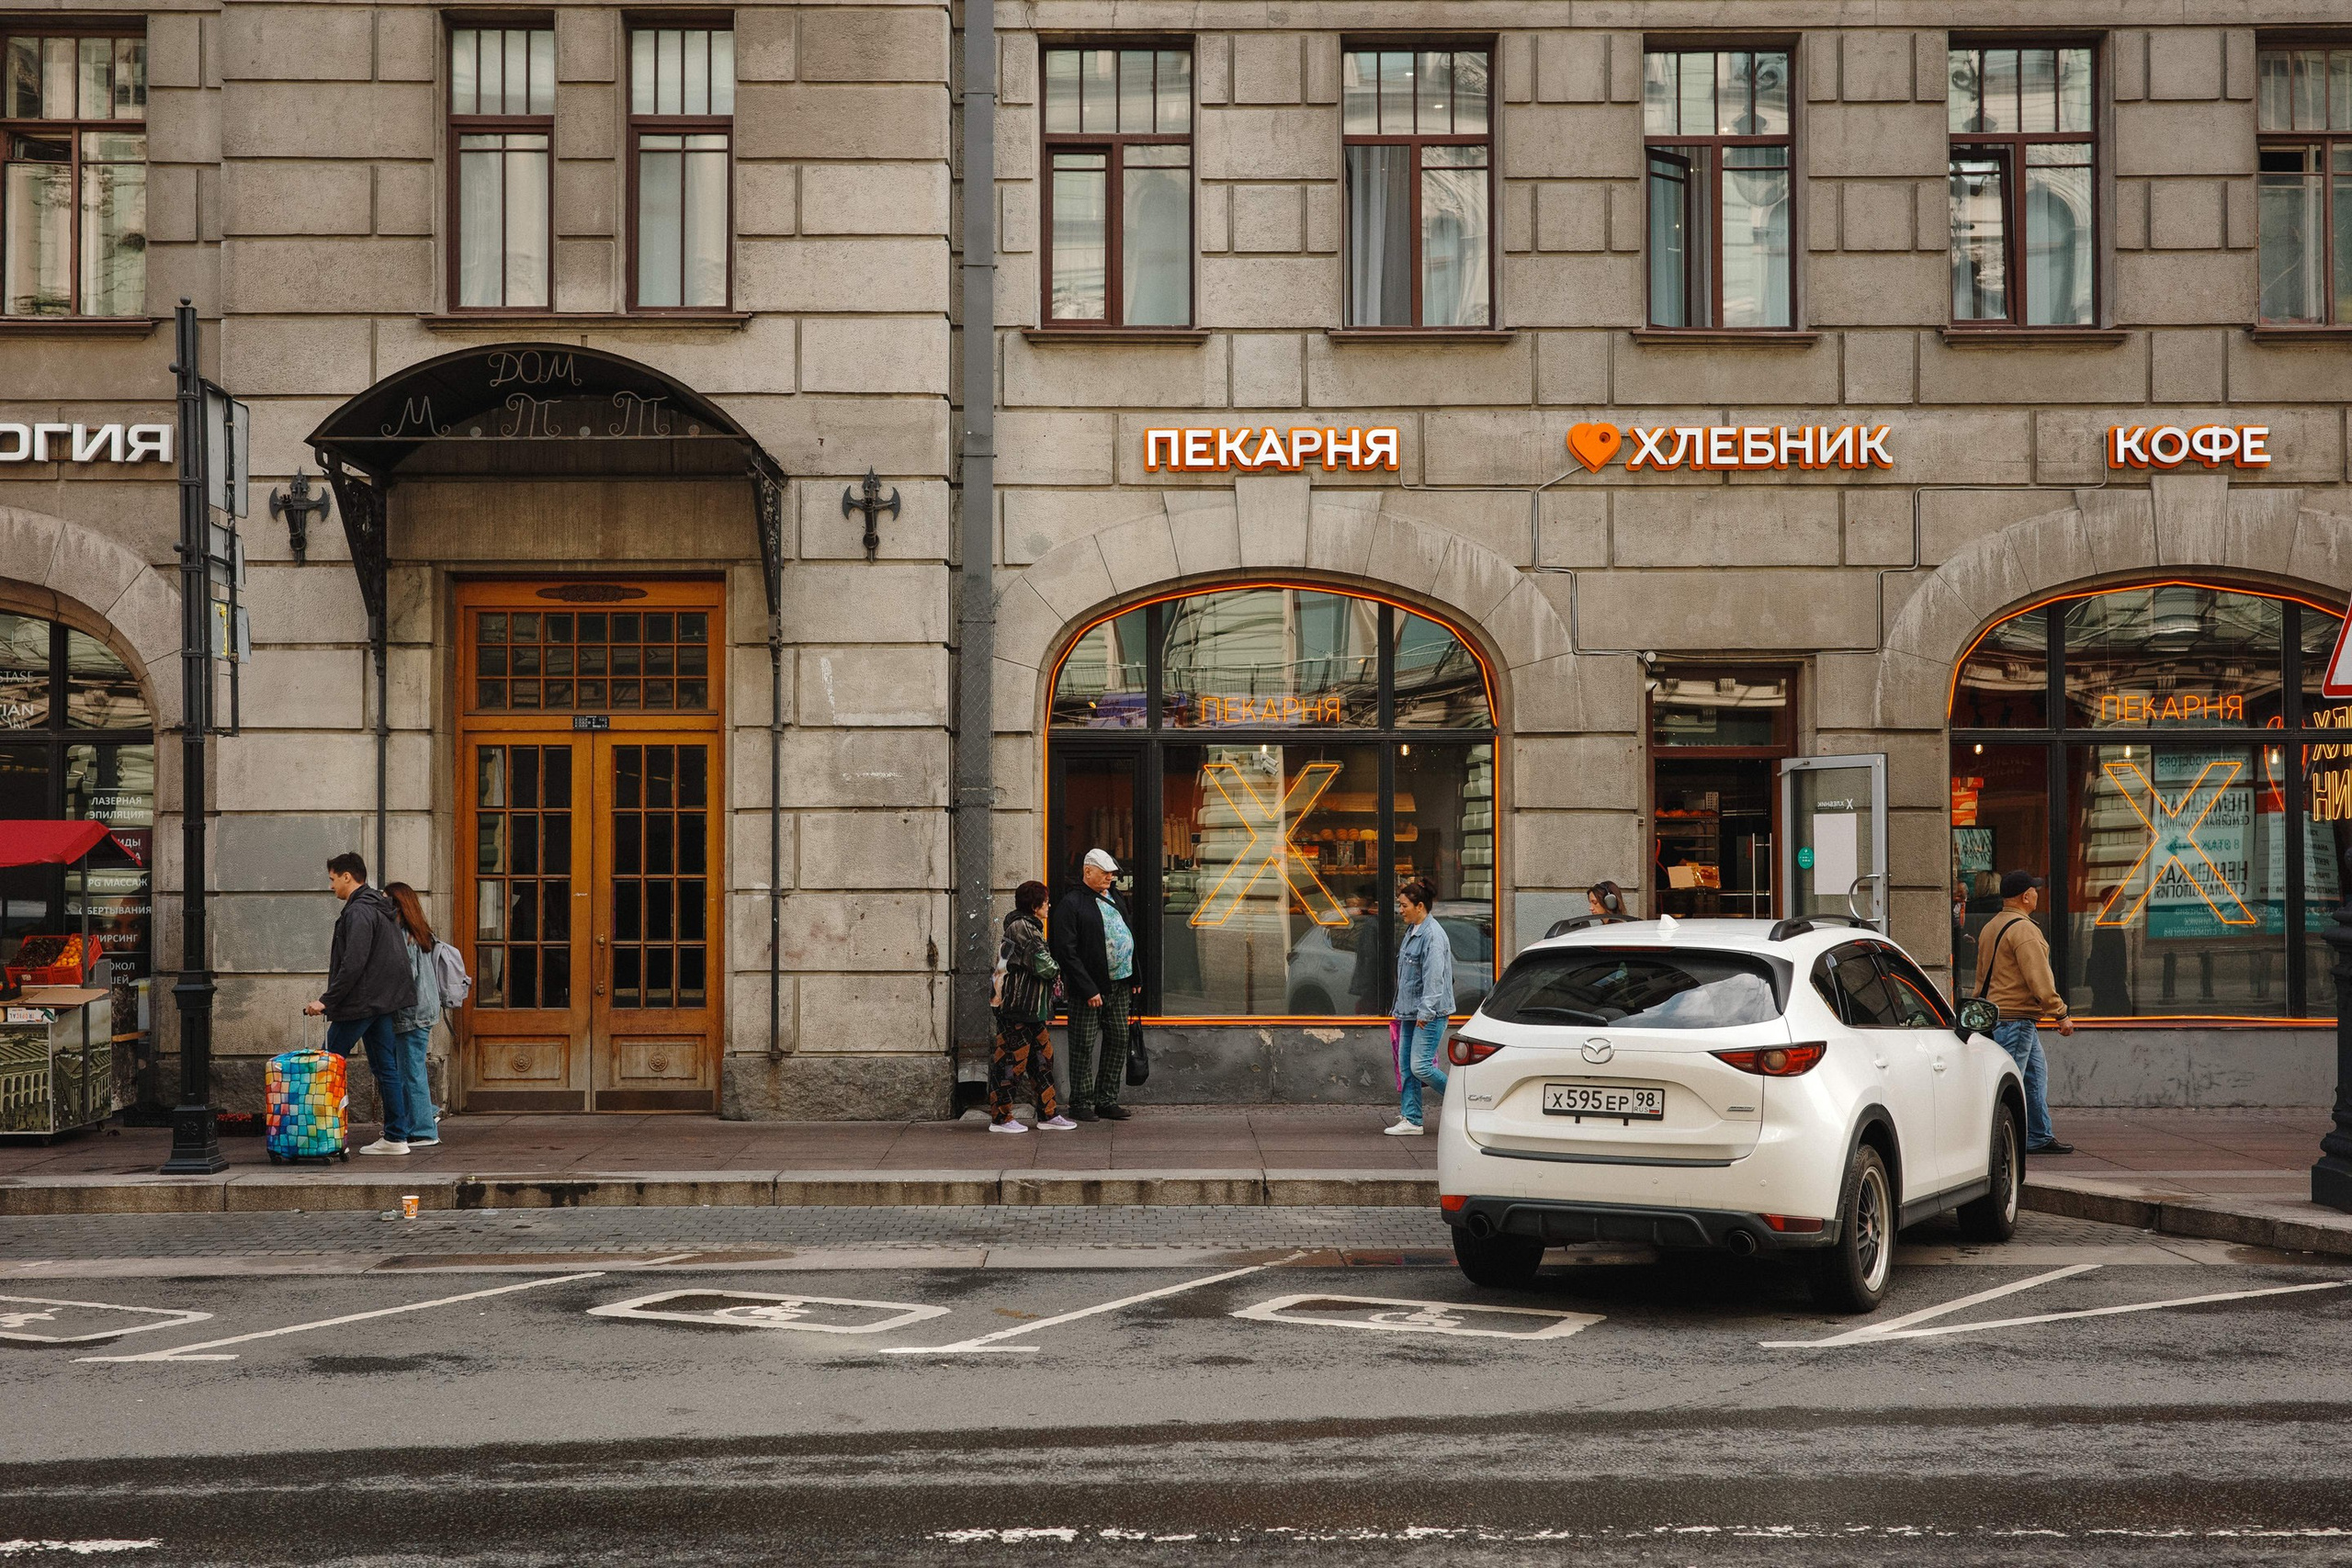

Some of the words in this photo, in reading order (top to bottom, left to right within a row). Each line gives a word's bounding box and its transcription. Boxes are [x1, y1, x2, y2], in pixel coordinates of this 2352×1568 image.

[488, 350, 582, 387] ДОМ
[0, 423, 175, 463] ОГИЯ
[1146, 427, 1399, 469] ПЕКАРНЯ
[1627, 425, 1894, 469] ХЛЕБНИК
[2109, 425, 2271, 468] КОФЕ
[1202, 697, 1341, 723] ПЕКАРНЯ
[2100, 694, 2243, 721] ПЕКАРНЯ
[2312, 705, 2352, 761] ХЛ
[91, 796, 142, 806] ЛАЗЕРНАЯ
[89, 810, 144, 820] ЭПИЛЯЦИЯ
[118, 838, 141, 849] ИДЫ
[87, 878, 101, 887] PG
[104, 878, 148, 887] МАССАЖ
[1636, 1092, 1655, 1107] 98
